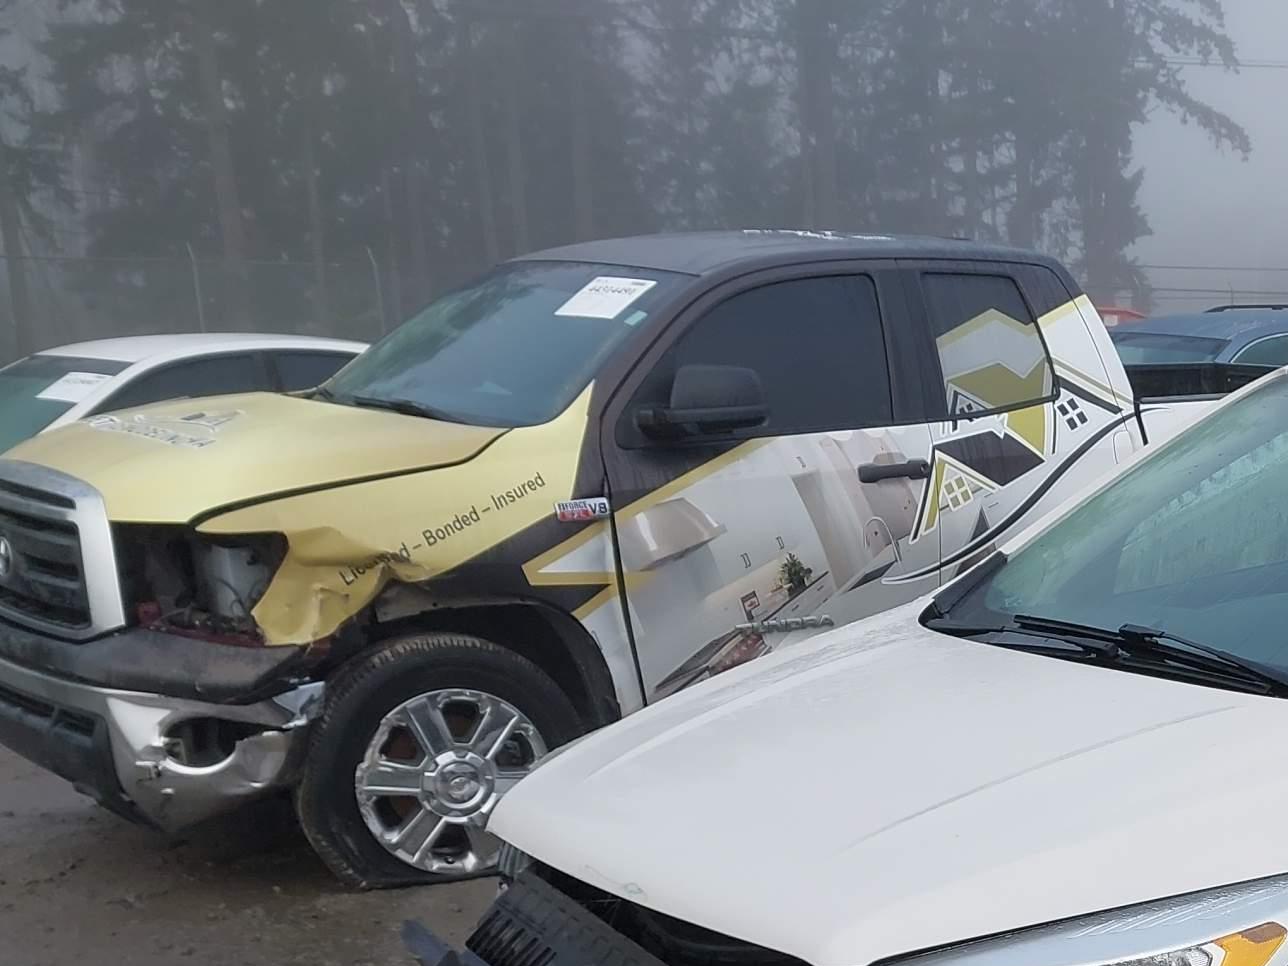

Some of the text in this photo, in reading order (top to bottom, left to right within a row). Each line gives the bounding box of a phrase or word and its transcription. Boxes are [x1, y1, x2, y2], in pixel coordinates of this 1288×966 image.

[422, 506, 480, 547] Bonded
[491, 472, 546, 510] Insured
[588, 502, 608, 514] V8
